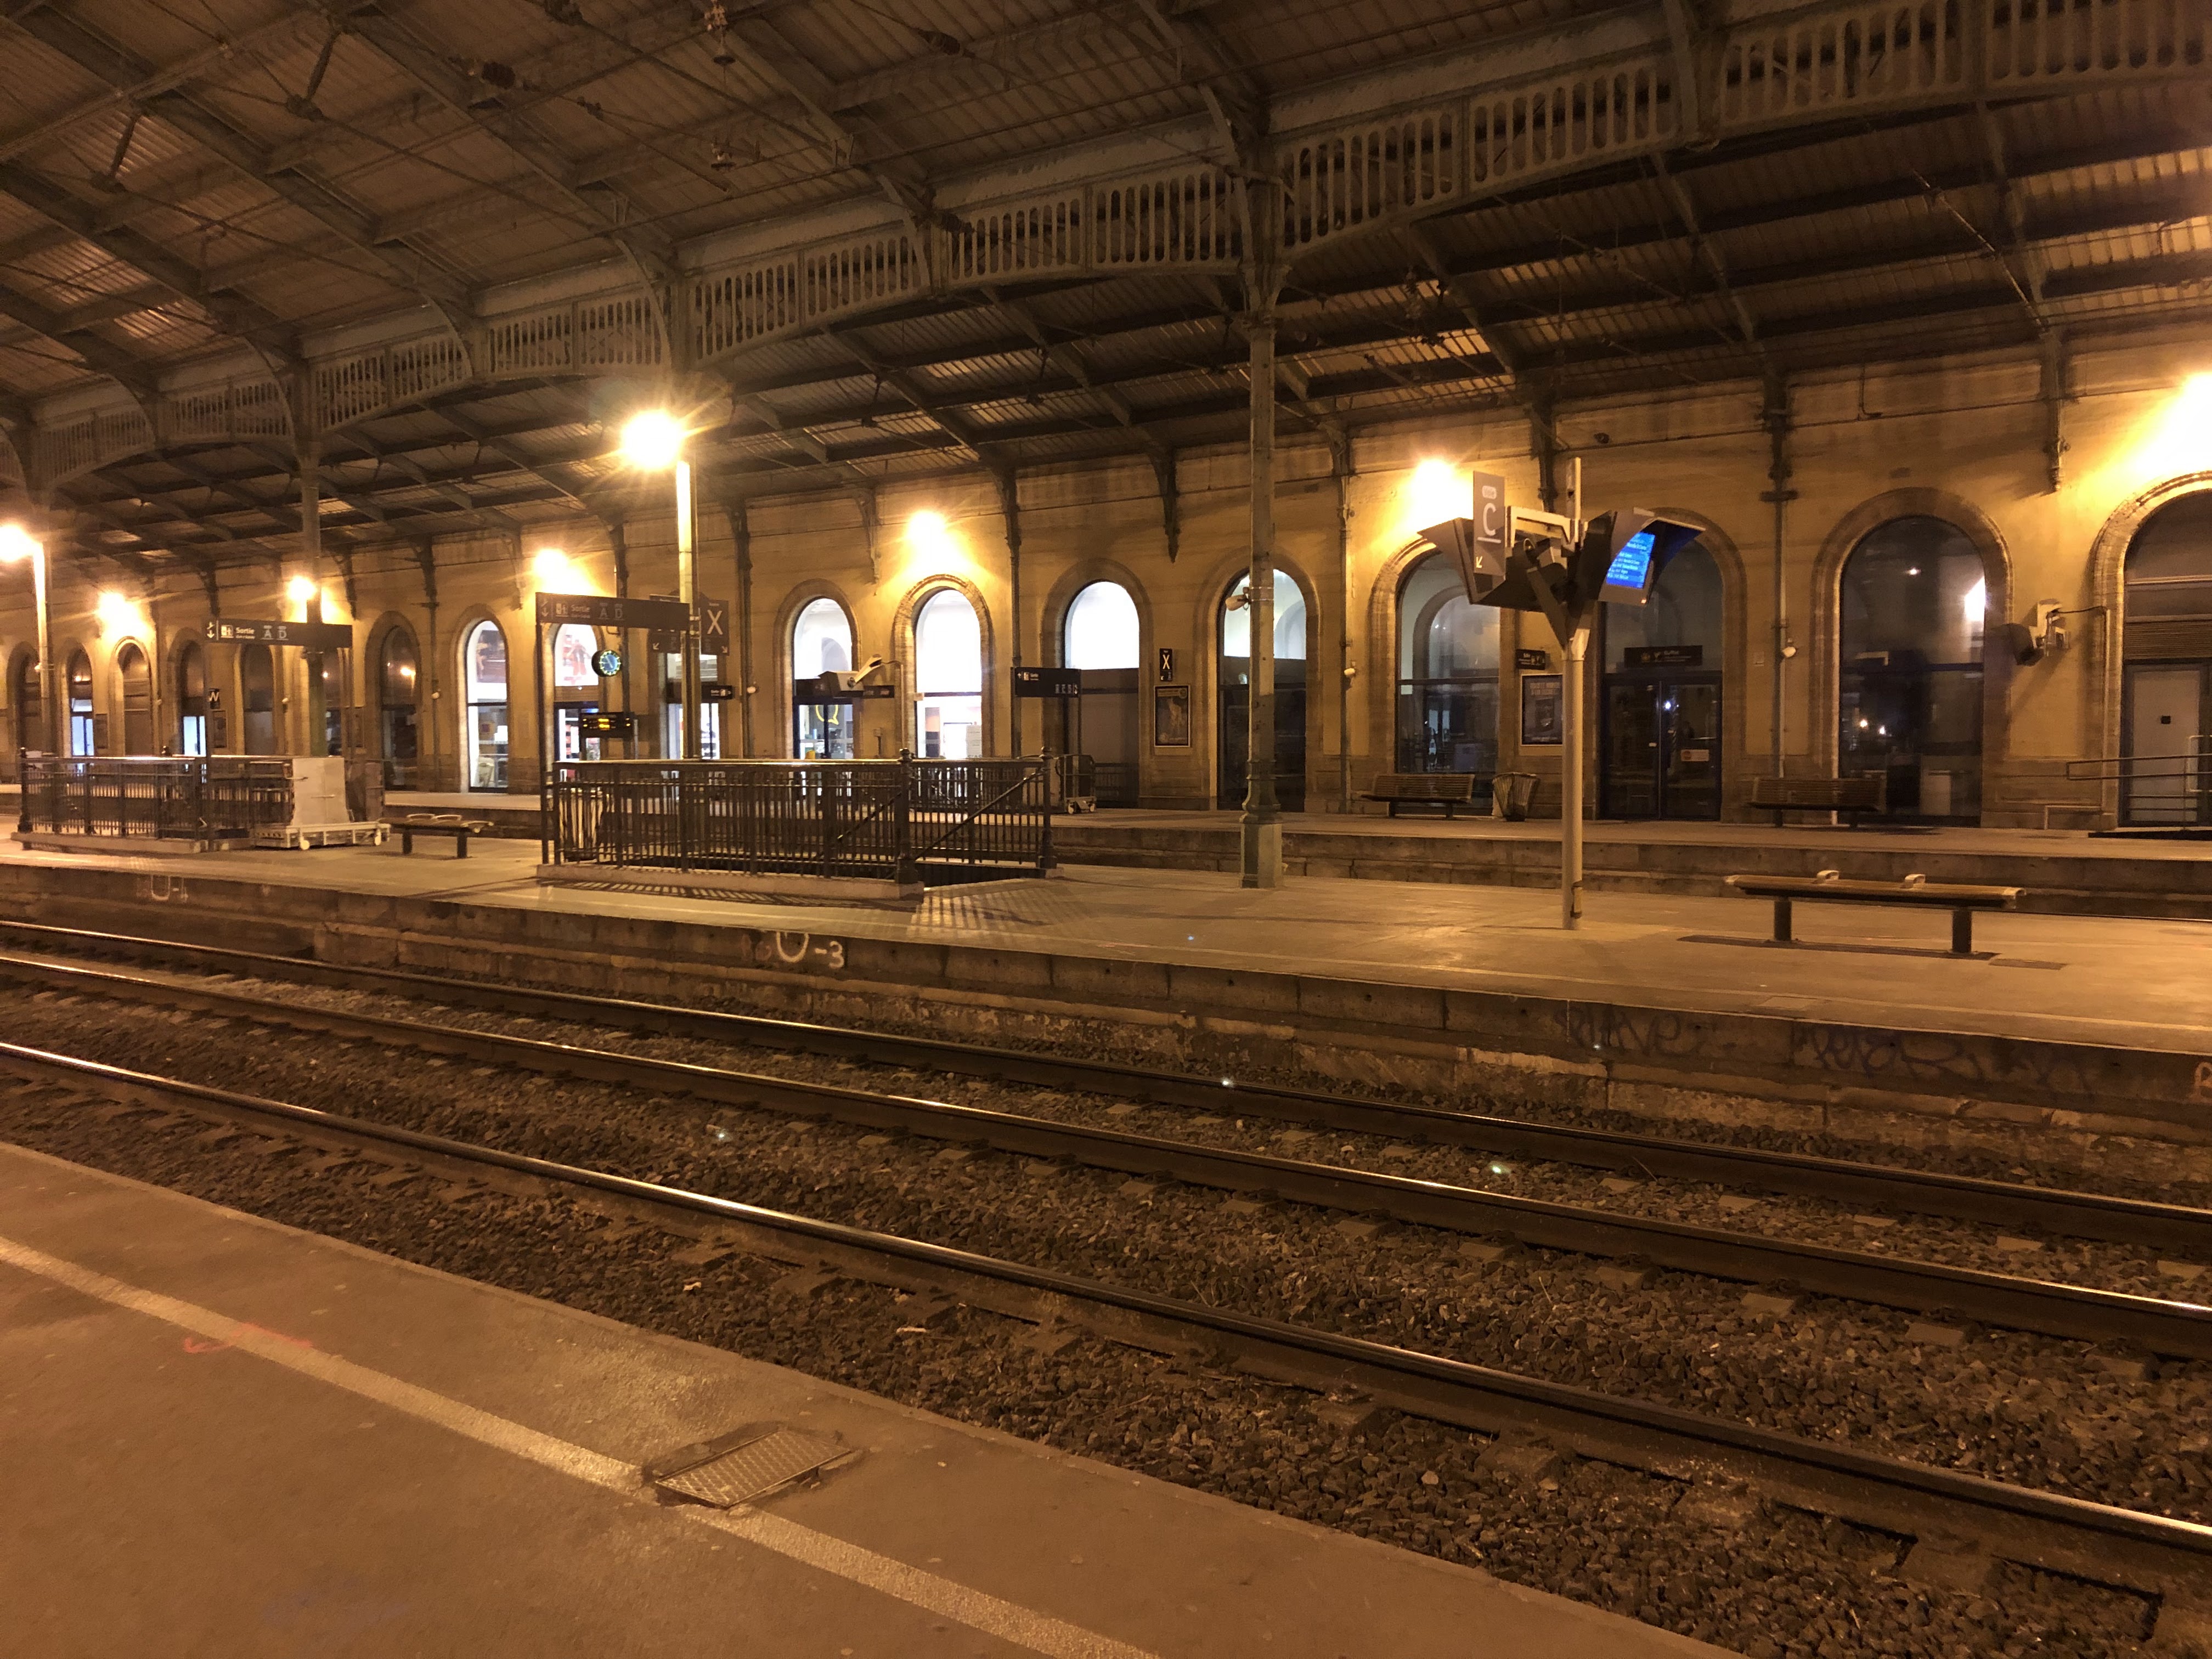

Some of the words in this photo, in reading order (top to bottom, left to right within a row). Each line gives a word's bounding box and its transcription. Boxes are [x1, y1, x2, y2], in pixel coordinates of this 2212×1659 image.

[1483, 503, 1497, 537] C
[615, 608, 623, 618] D
[707, 610, 723, 635] X
[264, 630, 273, 639] A
[279, 630, 287, 639] D
[1163, 654, 1170, 670] X
